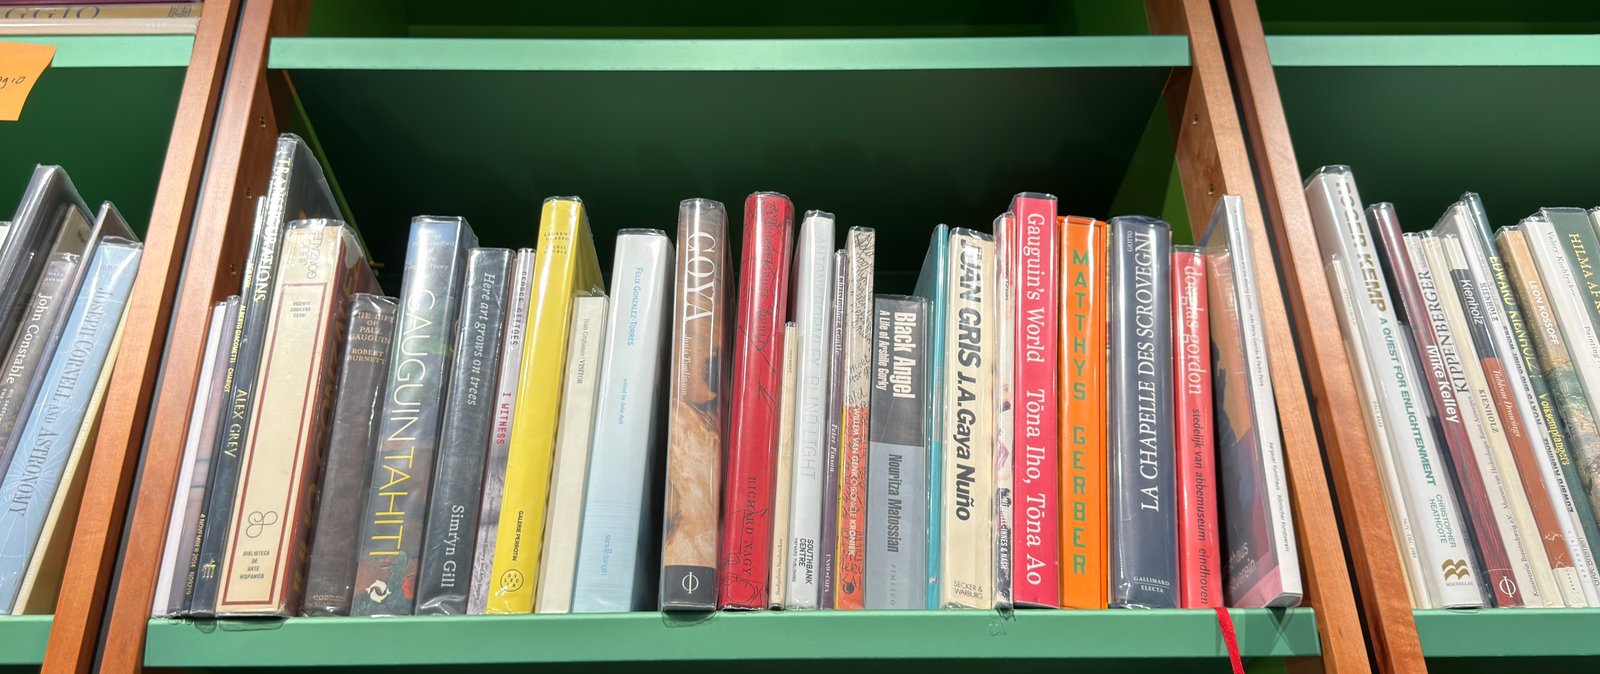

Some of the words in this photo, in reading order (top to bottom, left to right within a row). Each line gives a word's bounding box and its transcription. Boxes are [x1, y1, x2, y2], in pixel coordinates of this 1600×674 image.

[1023, 213, 1045, 300] Gauguin's
[1569, 233, 1594, 278] HILMA
[1587, 281, 1600, 298] AF
[481, 272, 496, 300] Here
[684, 232, 716, 322] GOYA
[1135, 231, 1154, 339] SCROVEGNI
[1180, 266, 1204, 328] douglas
[1356, 254, 1387, 312] KEMP
[1489, 255, 1515, 306] EDWARD
[33, 293, 52, 321] John
[80, 287, 113, 338] JOSEPH
[236, 304, 246, 331] ALBERTO
[478, 302, 489, 322] art
[1379, 317, 1388, 325] A
[1460, 279, 1484, 325] Kienholz
[1480, 282, 1499, 322] KIENHOLZ
[1528, 280, 1543, 304] LEON
[1537, 304, 1560, 346] KOSSOFF
[474, 321, 487, 357] grows
[880, 318, 890, 330] Life
[893, 312, 916, 352] Black
[957, 307, 981, 369] GRIS
[1026, 308, 1045, 363] World
[1072, 249, 1089, 400] MATTHYS
[1418, 270, 1469, 393] KIPPENBERGER
[7, 324, 39, 384] Constable
[229, 330, 242, 363] GIACOMETTI
[351, 348, 385, 358] ROBERT
[392, 288, 436, 441] GAUGUIN
[879, 340, 889, 367] Arshile
[1137, 342, 1155, 376] DES
[1182, 333, 1207, 395] gordon
[1383, 327, 1400, 363] QUEST
[53, 341, 94, 401] CORNELL
[224, 367, 235, 393] CHARIOT
[472, 359, 483, 377] on
[577, 360, 586, 384] VISITOR
[876, 367, 889, 391] Gorky
[889, 355, 916, 399] Angel
[1394, 365, 1407, 388] FOR
[1426, 345, 1444, 379] Mike
[1438, 381, 1460, 423] Kelley
[232, 389, 248, 420] ALEX
[467, 377, 482, 407] trees
[804, 376, 819, 424] BLIND
[1478, 389, 1498, 433] KIENHOLZ
[45, 403, 60, 424] AND
[496, 402, 511, 445] WITNESS
[852, 408, 861, 436] WILLEM
[1026, 388, 1045, 437] Tōna
[1138, 380, 1159, 480] CHAPELLE
[1192, 408, 1200, 448] stedelijk
[1501, 399, 1524, 437] Drawings
[224, 423, 242, 458] GREY
[800, 431, 817, 481] LIGHT
[852, 436, 860, 454] VAN
[1401, 390, 1436, 486] ENLIGHTENMENT
[9, 427, 57, 517] ASTRONOMY
[829, 447, 837, 473] Pinson
[851, 455, 859, 478] GENK
[887, 454, 903, 500] Nouritza
[1022, 444, 1045, 484] Iho,
[1194, 451, 1202, 468] van
[369, 446, 414, 556] TAHITI
[744, 477, 757, 535] RICHARD
[955, 463, 976, 522] Nuño
[1073, 426, 1087, 575] GERBER
[1141, 486, 1159, 512] LA
[1195, 472, 1207, 541] abbemuseum
[1271, 464, 1281, 490] Kunsthaus
[1280, 521, 1291, 551] Kunstverein
[1496, 484, 1511, 510] Museum
[445, 504, 465, 561] Simryn
[516, 511, 524, 536] GALERIE
[847, 518, 857, 556] KRONIEK
[887, 498, 902, 553] Matossian
[1026, 493, 1046, 547] Tōna
[1429, 498, 1448, 544] HEATHCOTE
[1436, 494, 1457, 548] CHRISTOPHER
[511, 536, 521, 561] PERROTIN
[743, 538, 753, 575] NAGY
[799, 538, 807, 567] CENTRE
[806, 539, 814, 585] SOUTHBANK
[1509, 524, 1528, 562] Braunschweig
[440, 559, 457, 588] Gill
[954, 580, 974, 591] SECKER
[1026, 553, 1046, 586] Ao
[1133, 576, 1170, 586] GALLIMARD
[1141, 585, 1164, 593] ELECTA
[1199, 548, 1211, 605] eindhoven
[1522, 562, 1540, 597] Kunstverein
[954, 587, 983, 599] WARBURG
